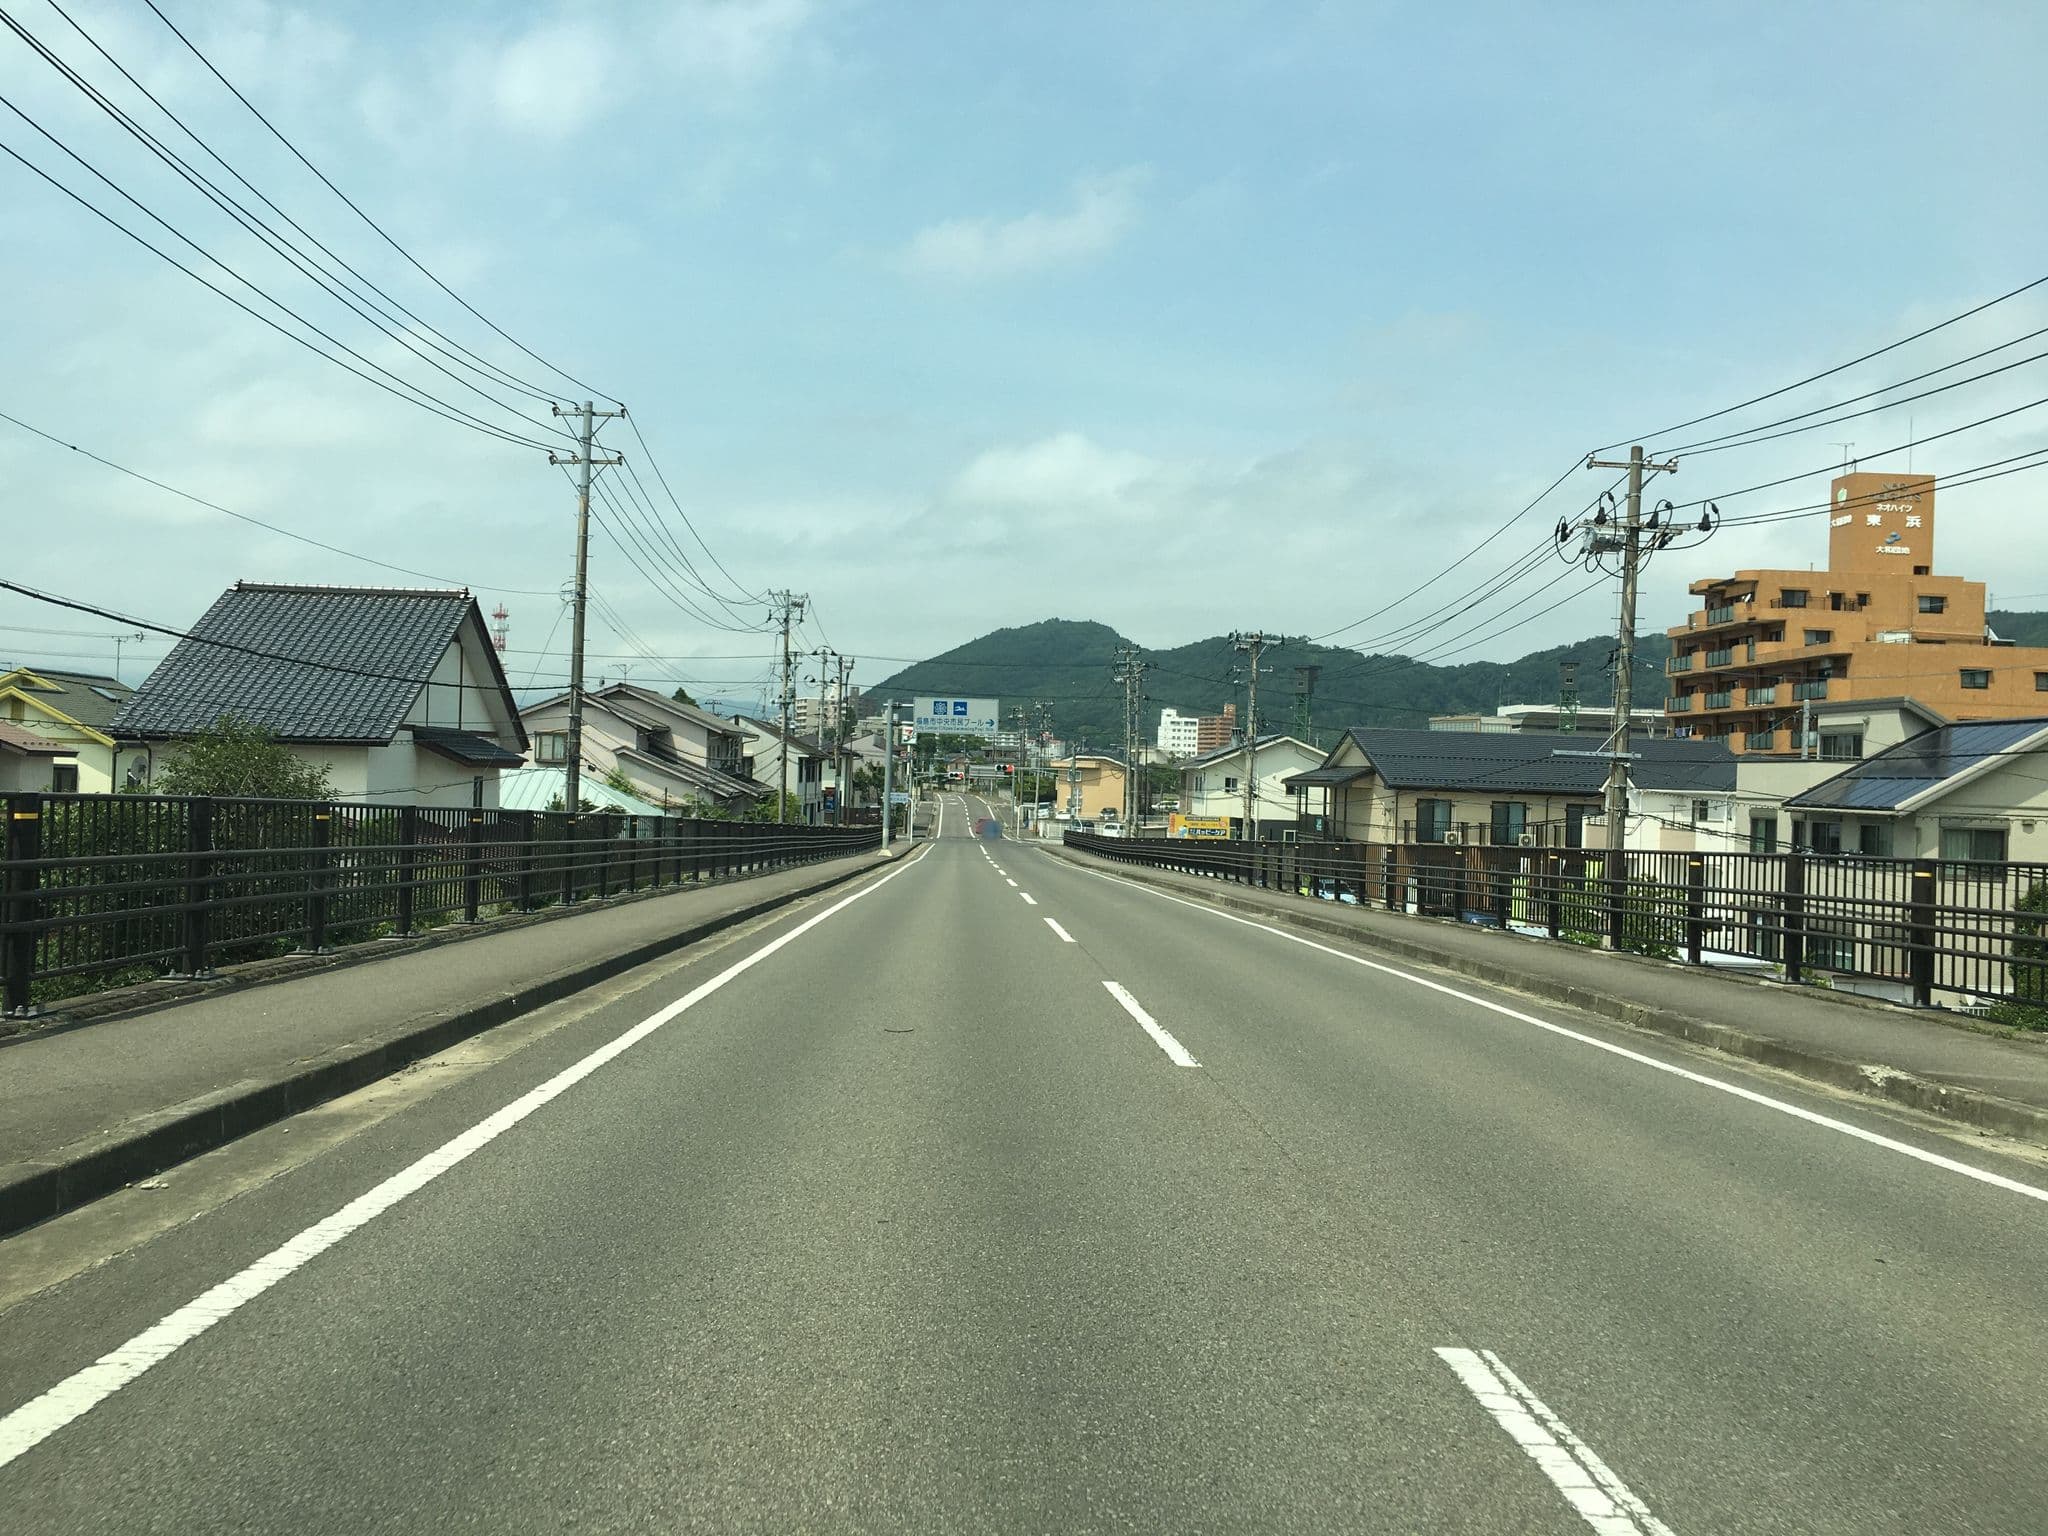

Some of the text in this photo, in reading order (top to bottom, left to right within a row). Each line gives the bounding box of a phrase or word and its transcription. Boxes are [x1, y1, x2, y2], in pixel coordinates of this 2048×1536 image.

[1876, 503, 1912, 512] ネオハイツ
